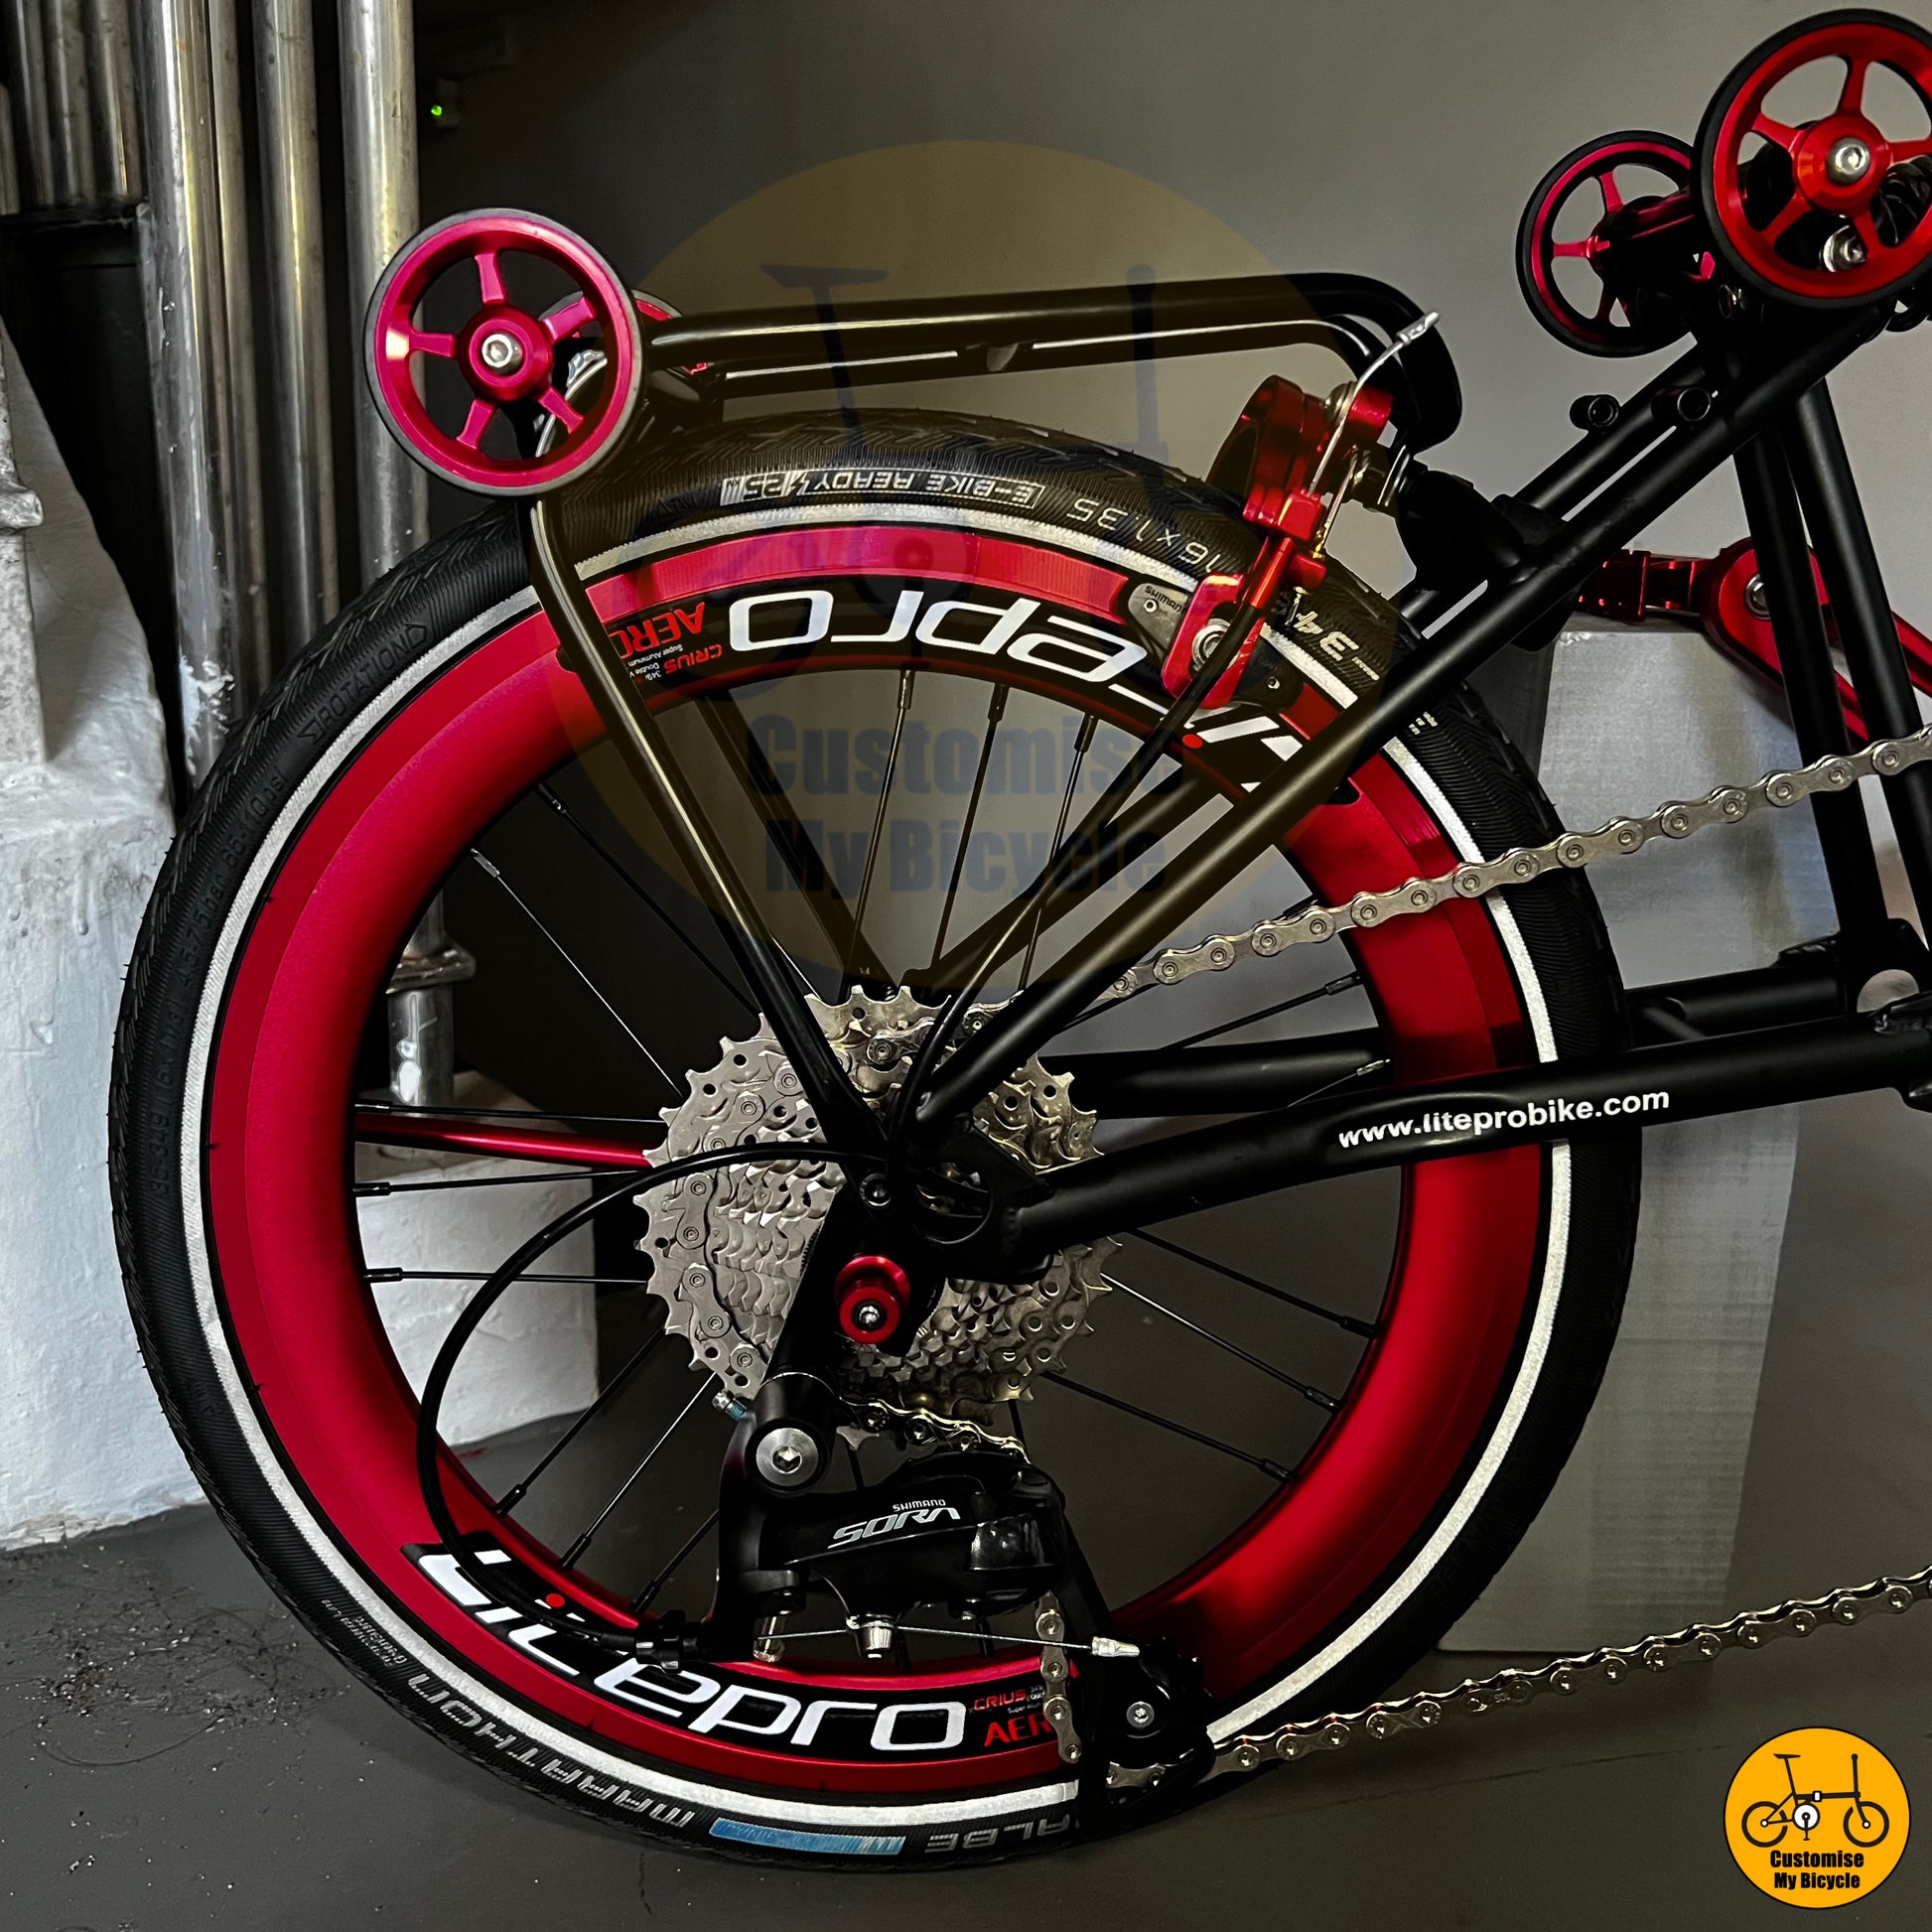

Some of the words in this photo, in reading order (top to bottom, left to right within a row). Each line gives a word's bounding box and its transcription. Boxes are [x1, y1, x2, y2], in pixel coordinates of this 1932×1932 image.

[813, 471, 915, 490] READY
[925, 473, 1034, 504] E-BIKE
[1144, 585, 1183, 613] SHIMAN
[663, 643, 723, 674] CRIUS
[320, 632, 415, 731] ROTATION
[1338, 1090, 1670, 1149] www.liteprobike.com
[893, 1498, 946, 1512] SHIMANO
[827, 1507, 961, 1549] SORA
[973, 1688, 1028, 1712] CRIUS
[984, 1712, 1053, 1747] AER
[408, 1673, 696, 1829] MARATHON
